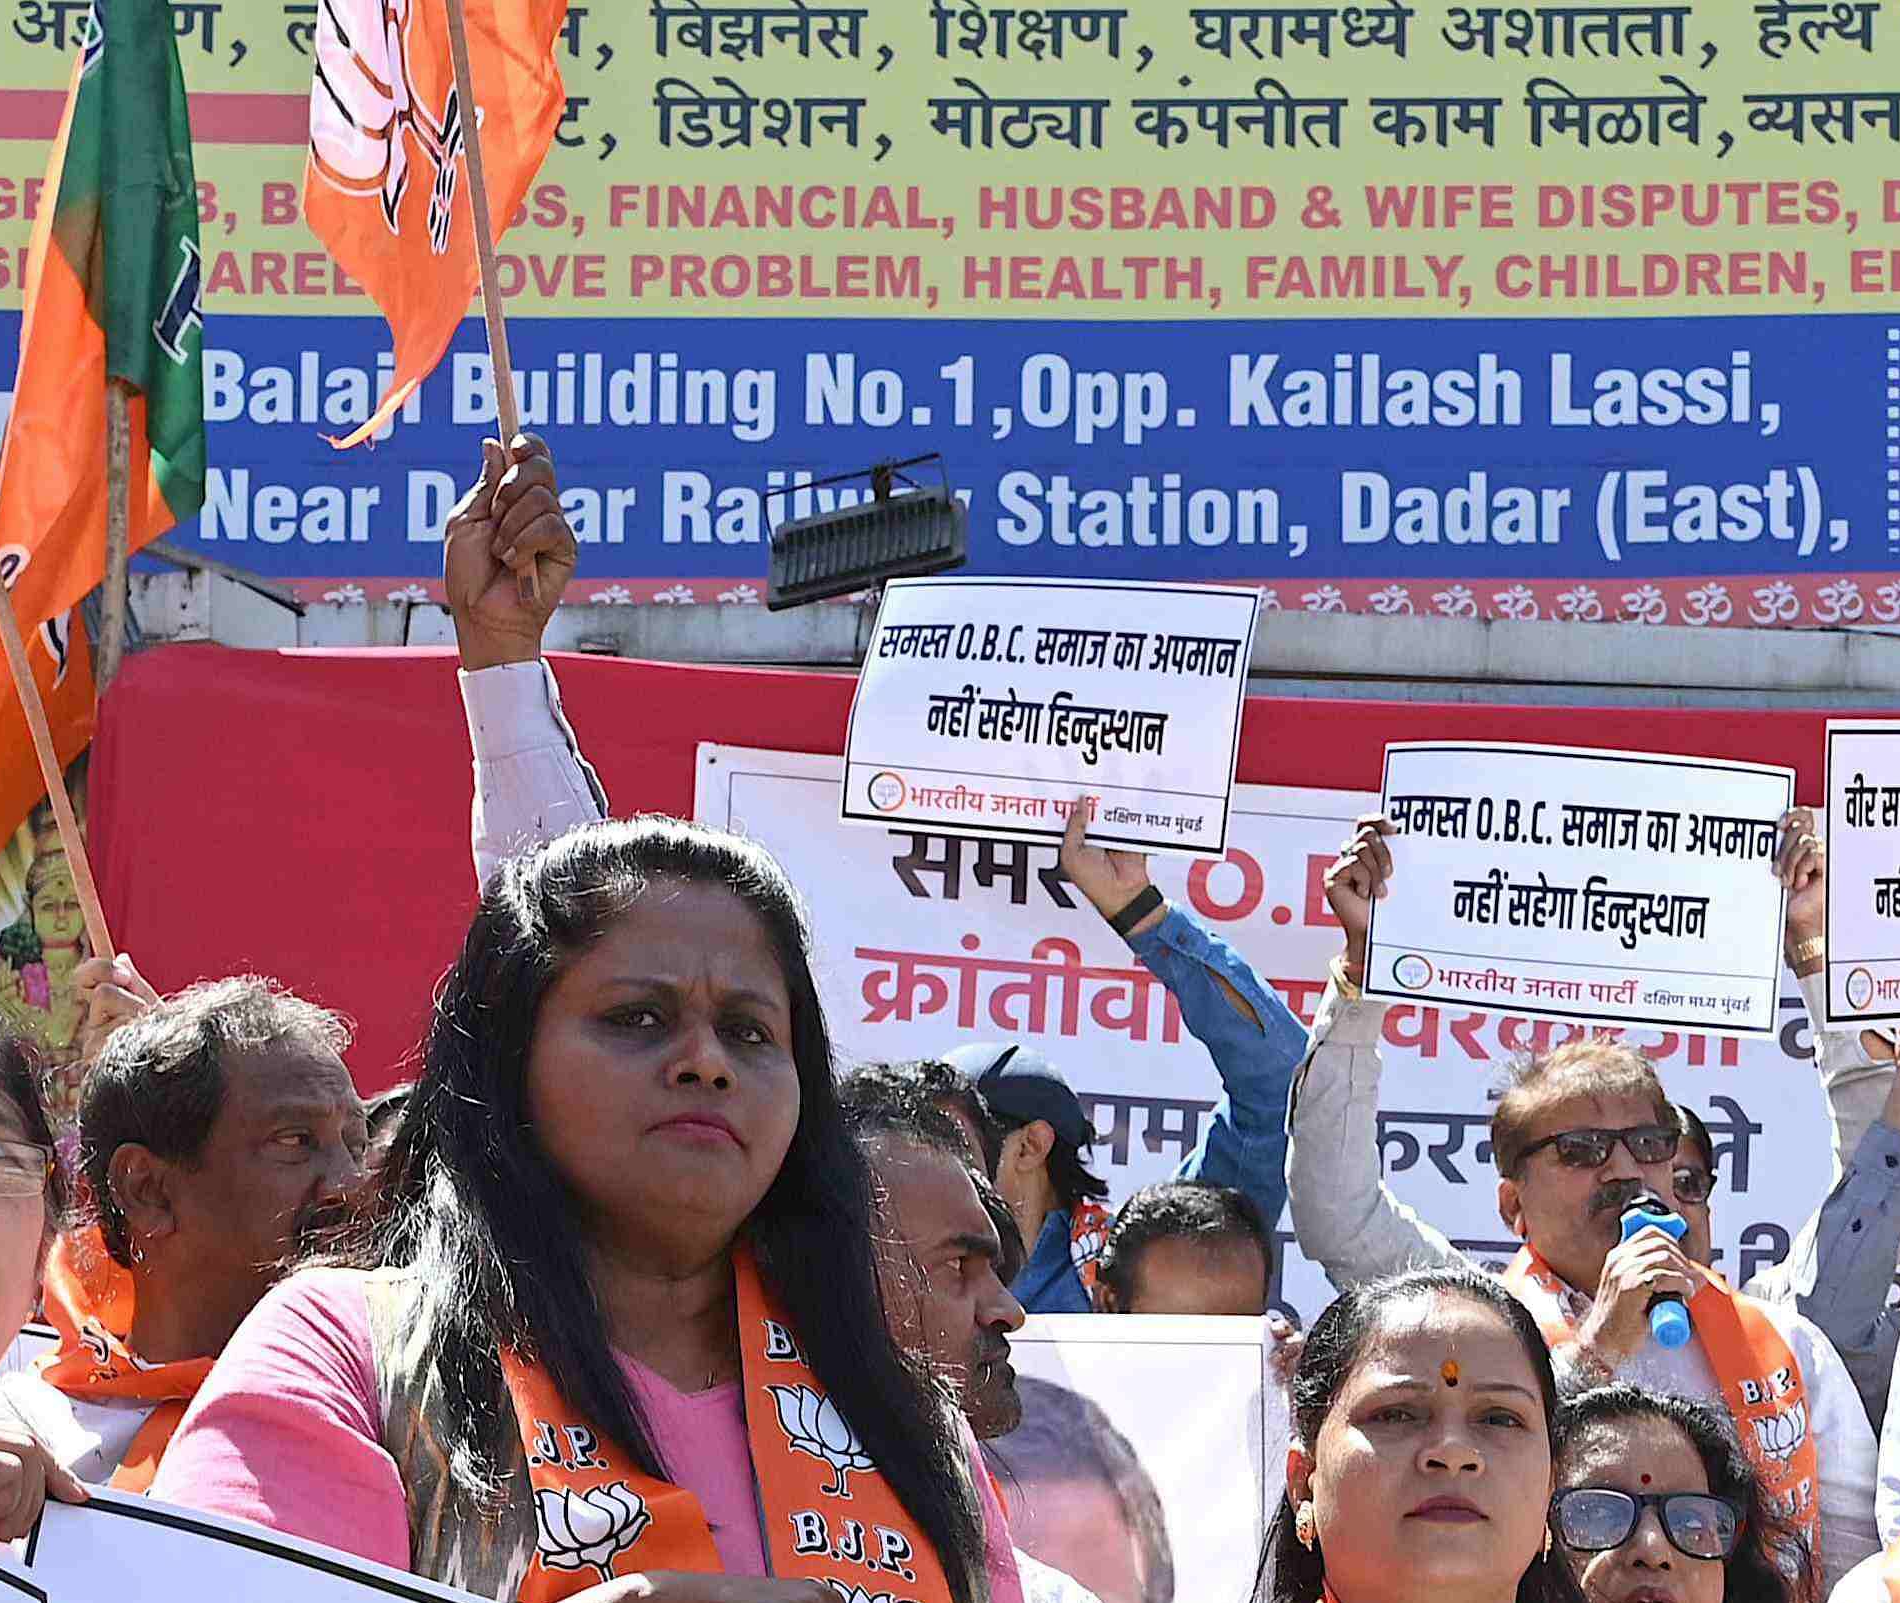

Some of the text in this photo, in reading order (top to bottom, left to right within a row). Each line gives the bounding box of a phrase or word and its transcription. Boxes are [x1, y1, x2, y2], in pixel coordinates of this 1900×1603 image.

[930, 77, 1110, 149] मोठ्या
[1132, 75, 1348, 149] कंपनीत
[1371, 93, 1502, 148] काम
[609, 185, 956, 238] FINANCIAL,
[980, 184, 1277, 229] HUSBAND
[1300, 184, 1342, 228] &
[1365, 184, 1513, 228] WIFE
[1537, 180, 1859, 235] DISPUTES,
[629, 253, 938, 309] PROBLEM,
[962, 254, 1221, 309] HEALTH,
[1245, 254, 1472, 308] FAMILY,
[1495, 251, 1827, 305] CHILDREN,
[452, 350, 776, 443] Building
[1227, 351, 1523, 428] Kailash
[1549, 350, 1781, 438] Lassi,
[200, 466, 1851, 560] Near Station, Dadar (East),
[879, 624, 955, 660] समस्त
[1035, 627, 1107, 668] समाज
[1113, 632, 1147, 671] का
[1150, 634, 1241, 679] अपमान
[927, 684, 980, 738] नहीं
[978, 688, 1043, 745] सहेगा
[908, 785, 983, 815] भारतीय
[990, 792, 1046, 818] जनता
[1389, 795, 1471, 839] समस्त
[1560, 803, 1639, 851] समाज
[1646, 809, 1681, 854] का
[1684, 814, 1778, 863] अपमान
[1845, 774, 1878, 827] वीर
[1453, 868, 1509, 929] नहीं
[1508, 872, 1577, 931] सहेगा
[1438, 967, 1516, 994] भारतीय
[1524, 978, 1582, 1000] जनता
[1588, 978, 1638, 1005] पार्टी
[790, 1509, 917, 1583] B.J.P.
